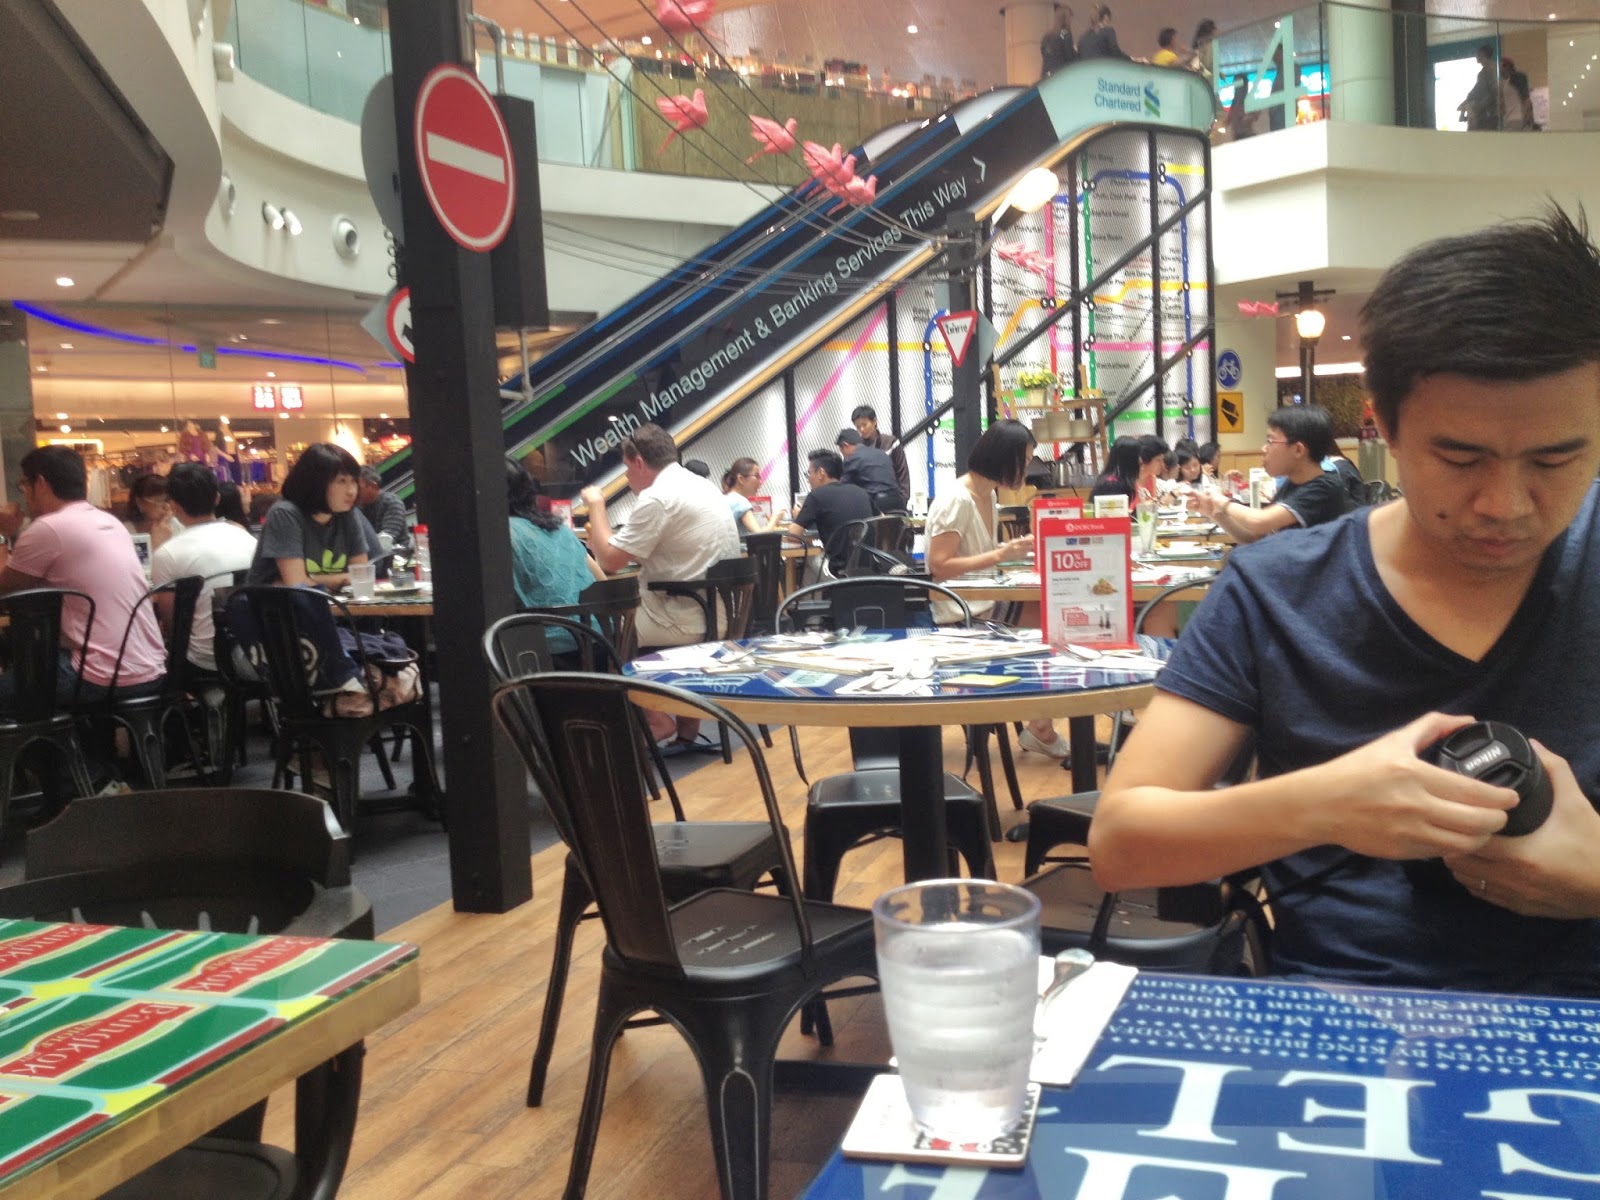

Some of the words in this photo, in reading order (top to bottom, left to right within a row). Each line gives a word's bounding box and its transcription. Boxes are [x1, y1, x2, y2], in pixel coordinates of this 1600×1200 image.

[1097, 78, 1140, 97] Standard
[1094, 94, 1141, 112] Chartered
[569, 413, 642, 468] Wealth
[638, 335, 756, 421] Management
[754, 316, 772, 339] &
[768, 271, 838, 328] Banking
[835, 223, 903, 280] Services
[899, 201, 935, 232] This
[932, 176, 968, 208] Way
[1136, 1004, 1312, 1027] Mahinthara
[1267, 1001, 1394, 1019] Burirom
[1458, 1001, 1551, 1017] Sathit
[1324, 1017, 1538, 1043] Rattanakosin
[1406, 1010, 1600, 1033] Ratchathani
[1197, 1031, 1308, 1049] BUDDHA
[1317, 1041, 1386, 1055] KING
[1395, 1048, 1427, 1059] BY
[1436, 1050, 1528, 1065] GIVEN
[1535, 1058, 1600, 1071] CITY
